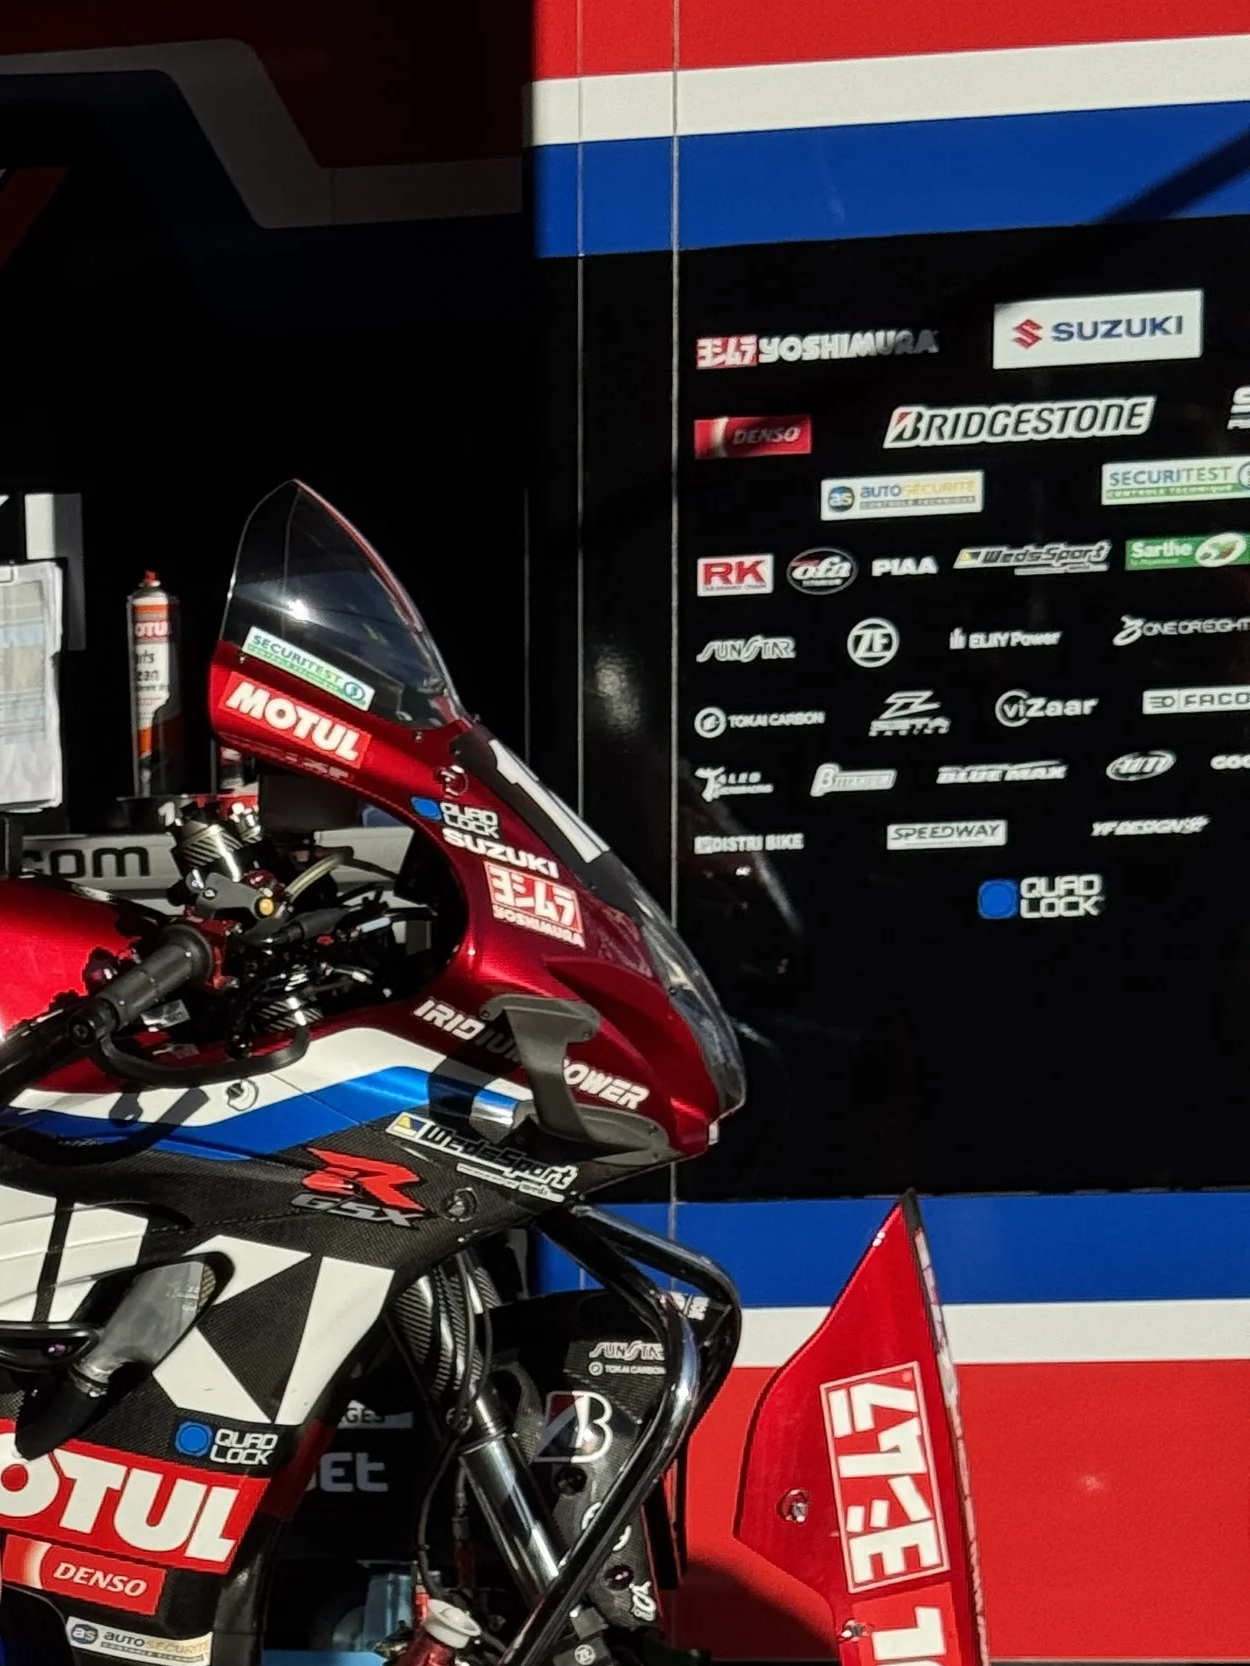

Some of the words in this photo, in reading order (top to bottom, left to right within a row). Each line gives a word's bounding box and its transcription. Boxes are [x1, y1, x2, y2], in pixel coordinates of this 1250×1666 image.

[1051, 314, 1184, 342] SUZUKI
[758, 330, 939, 364] YOSHIMURA
[891, 401, 1148, 444] BRIDGESTONE
[732, 426, 801, 445] DENSO
[1109, 465, 1232, 487] SECURITEST
[1131, 540, 1194, 559] Sarthe
[702, 560, 766, 586] RK
[871, 556, 939, 577] PIAA
[135, 620, 170, 639] OTU
[1011, 630, 1062, 648] Power
[253, 634, 345, 685] SECURITEST
[769, 710, 826, 727] CARBON
[1002, 696, 1100, 719] viZaar
[225, 681, 361, 762] MOTUL
[440, 801, 498, 826] QUAD
[765, 833, 805, 851] BIKE
[892, 823, 1001, 842] SPEEDWAY
[442, 828, 560, 879] SUZUKI
[1019, 874, 1103, 898] QUAD
[1020, 896, 1104, 919] LOCK
[492, 903, 586, 950] YOSHIMURA
[563, 1057, 651, 1110] OWER
[290, 1192, 426, 1229] GSX
[214, 1428, 279, 1451] QUAD
[209, 1444, 271, 1465] LOCK
[827, 1369, 945, 1586] ヨシムラ
[52, 1561, 148, 1597] DENSO
